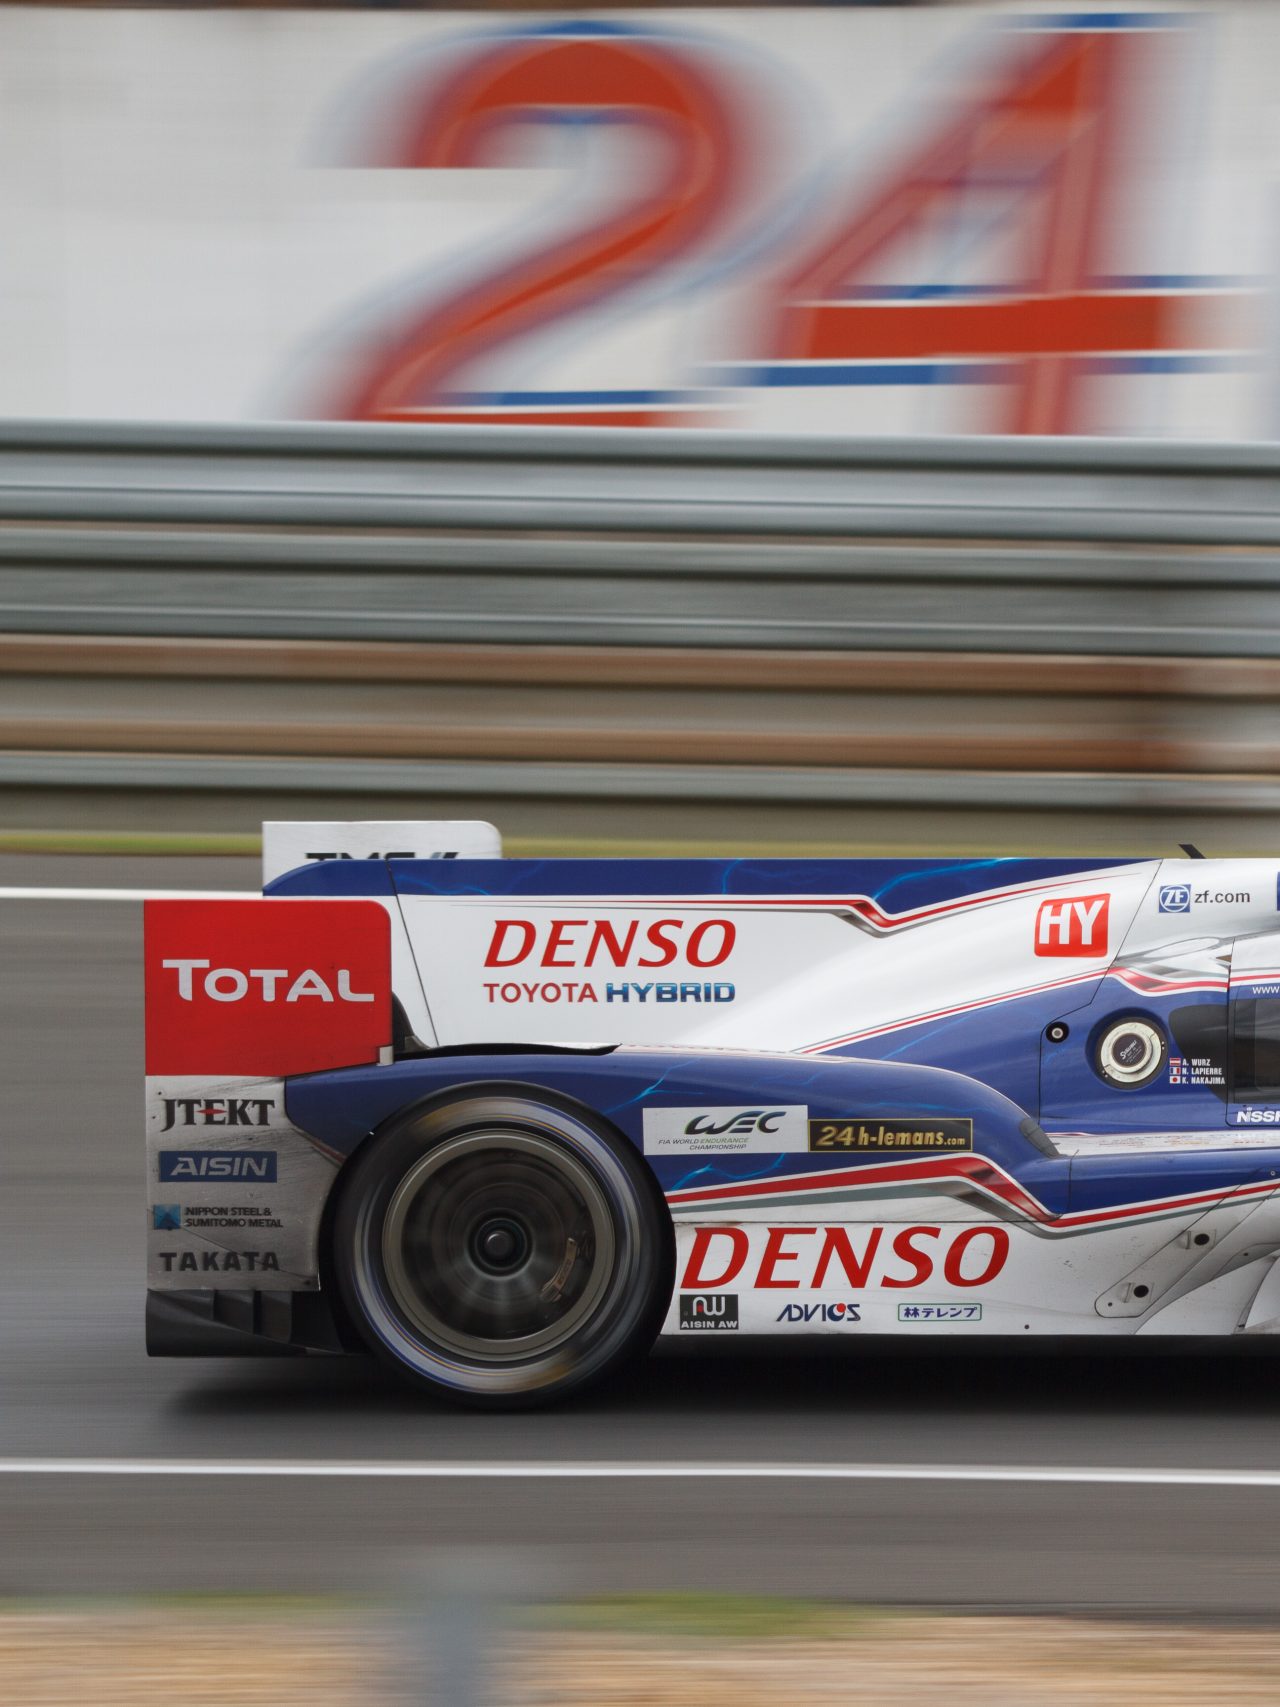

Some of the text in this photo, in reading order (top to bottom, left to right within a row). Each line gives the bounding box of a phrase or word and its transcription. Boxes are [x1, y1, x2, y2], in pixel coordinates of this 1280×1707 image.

[300, 14, 1240, 437] 24
[1194, 889, 1251, 904] zf.com
[1038, 899, 1105, 945] HY
[483, 918, 737, 968] DENSO
[162, 959, 375, 1003] TOTAL
[483, 982, 737, 1004] TOYOTA HYBRID
[159, 1098, 276, 1133] JTEKT
[684, 1110, 787, 1135] WEC
[169, 1156, 268, 1177] AISIN
[185, 1206, 273, 1217] NIPPON STEEL &
[184, 1217, 284, 1229] SUMITOMO METAL
[158, 1251, 281, 1272] TAKATA
[680, 1226, 1010, 1290] DENSO
[903, 1306, 979, 1319] 林テレンプ
[681, 1320, 739, 1329] AISIN AW
